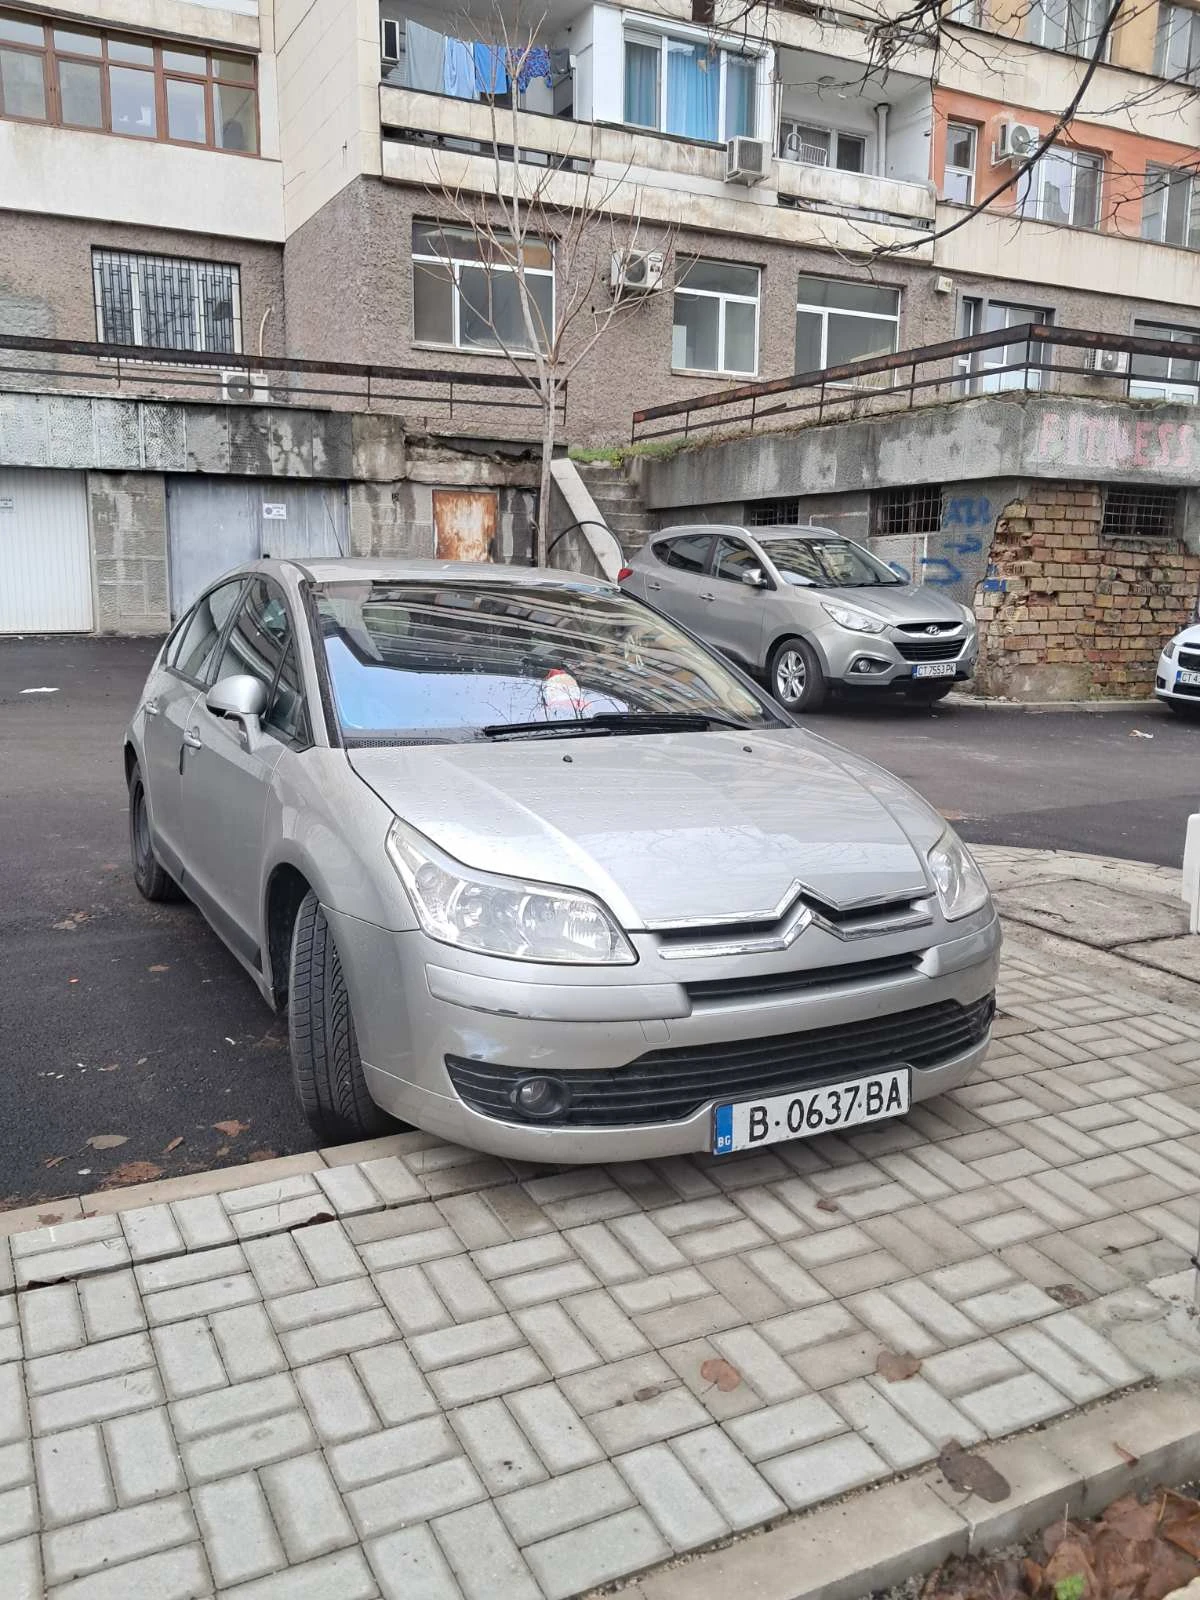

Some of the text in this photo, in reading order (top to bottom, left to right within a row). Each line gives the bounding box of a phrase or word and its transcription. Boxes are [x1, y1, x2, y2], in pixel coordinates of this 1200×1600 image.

[787, 1086, 860, 1133] 0637
[866, 1077, 902, 1116] BA
[717, 1135, 731, 1147] BG
